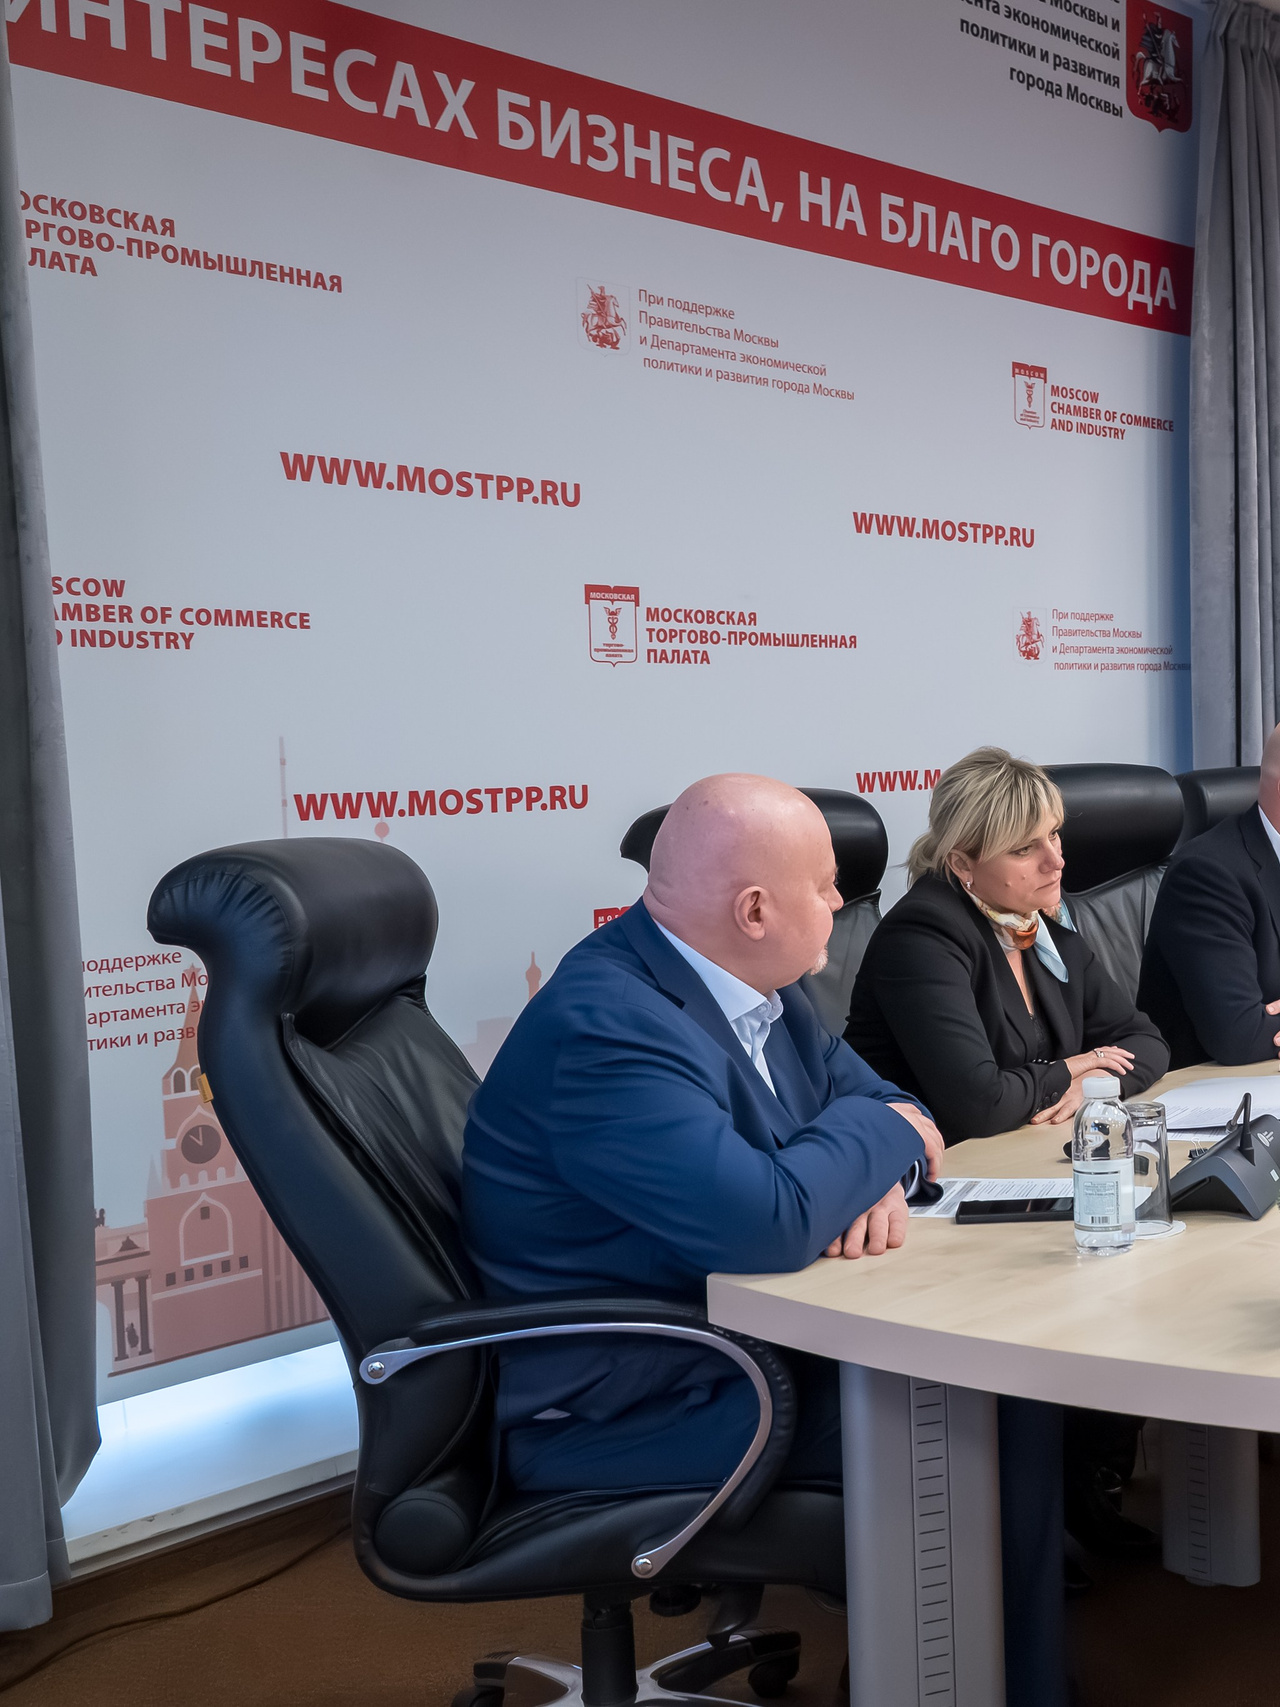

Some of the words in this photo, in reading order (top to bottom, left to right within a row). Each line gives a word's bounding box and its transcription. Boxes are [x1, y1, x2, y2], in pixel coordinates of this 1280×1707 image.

[1003, 4, 1120, 61] экономической
[1111, 17, 1120, 32] и
[960, 18, 1036, 59] политики
[1040, 48, 1049, 63] и
[1053, 52, 1120, 89] развития
[1009, 67, 1062, 98] города
[1066, 82, 1123, 118] Москвы
[497, 88, 784, 222] БИЗНЕСА,
[800, 171, 867, 236] НА
[881, 192, 1020, 271] БЛАГО
[1032, 233, 1176, 314] ГОРОДА
[638, 289, 664, 307] При
[667, 297, 735, 320] поддержке
[638, 310, 731, 339] Правительства
[733, 329, 779, 348] Москвы
[639, 335, 647, 345] и
[650, 334, 737, 361] Департамента
[739, 352, 827, 376] экономической
[643, 357, 702, 376] политики
[705, 366, 713, 378] и
[716, 368, 769, 387] развития
[771, 379, 810, 394] города
[812, 383, 855, 400] Москвы
[1050, 384, 1099, 404] MOSCOW
[1050, 402, 1102, 420] CHAMBER
[1104, 410, 1117, 423] OF
[1120, 412, 1174, 432] COMMERCE
[1050, 418, 1073, 432] AND
[1076, 422, 1126, 440] INDUSTRY
[280, 451, 581, 507] WWW.MOSTPP.RU
[852, 511, 1035, 549] WWW.MOSTPP.RU
[589, 592, 635, 600] МОСКОВСКАЯ
[140, 606, 172, 624] OF
[179, 607, 311, 629] COMMERCE
[646, 607, 757, 626] МОСКОВСКАЯ
[1052, 608, 1069, 622] При
[1070, 611, 1114, 623] поддержке
[70, 628, 195, 650] INDUSTRY
[646, 628, 857, 649] ТОРГОВО-ПРОМЫШЛЕННАЯ
[1052, 626, 1111, 639] Правительства
[1112, 628, 1142, 639] Москвы
[646, 648, 711, 665] ПАЛАТА
[1052, 645, 1057, 653] и
[1059, 643, 1114, 656] Департамента
[1116, 645, 1173, 656] экономической
[1054, 661, 1092, 671] политики
[1093, 662, 1099, 671] и
[1100, 661, 1135, 673] развития
[1136, 662, 1162, 673] города
[294, 785, 589, 821] WWW.MOSTPP.RU
[137, 1032, 148, 1045] и
